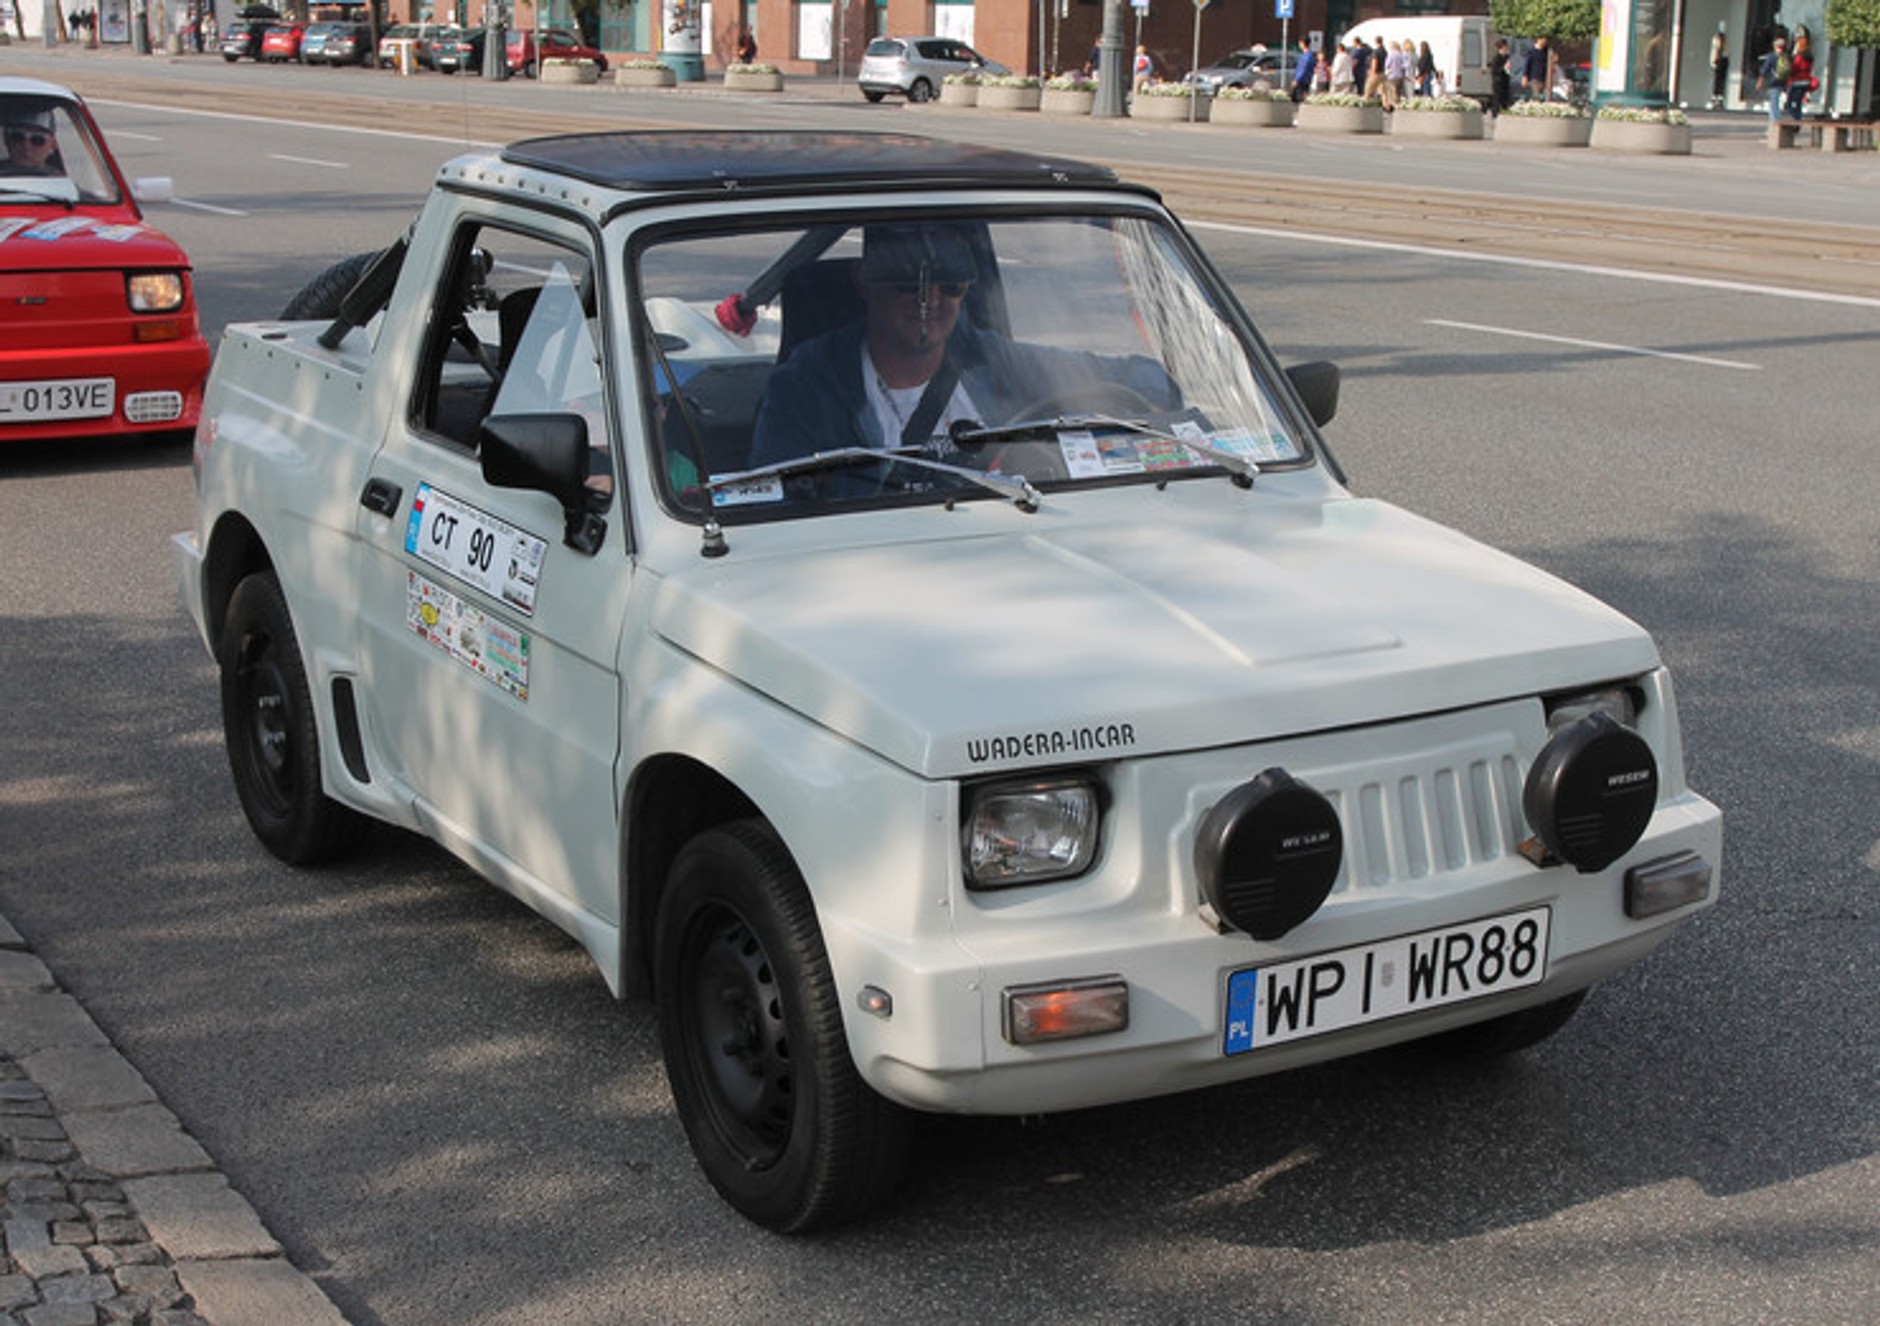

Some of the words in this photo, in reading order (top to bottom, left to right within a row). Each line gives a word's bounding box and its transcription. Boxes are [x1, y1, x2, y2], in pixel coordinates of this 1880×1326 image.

[23, 384, 108, 412] 013VE
[431, 512, 459, 550] CT
[468, 528, 495, 572] 90
[1408, 918, 1539, 1003] WR88
[1230, 1021, 1248, 1040] PL
